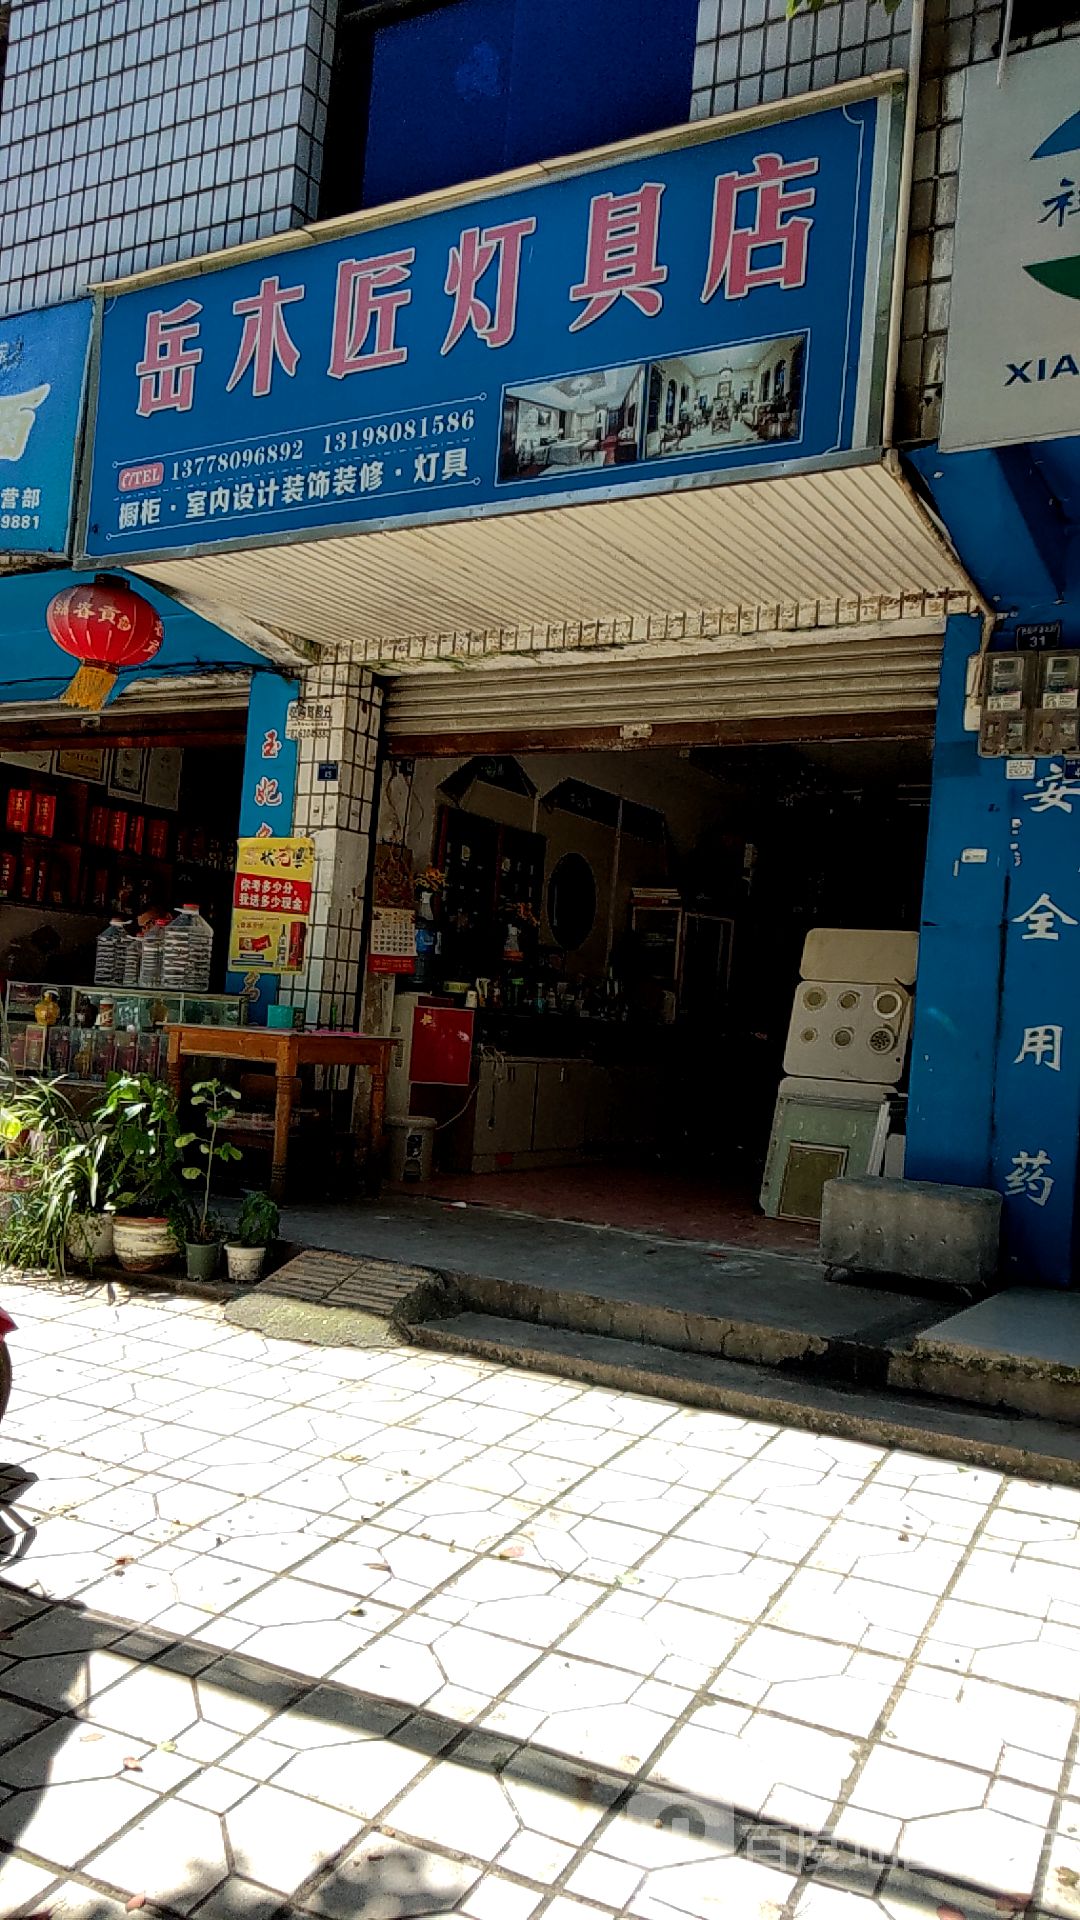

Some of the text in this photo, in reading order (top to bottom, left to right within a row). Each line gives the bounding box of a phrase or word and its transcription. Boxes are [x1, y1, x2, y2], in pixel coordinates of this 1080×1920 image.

[134, 152, 822, 419] 岳木匠灯具店
[133, 468, 161, 487] TEL
[170, 409, 475, 481] 13778096892 13198081586
[1029, 635, 1046, 649] 31
[1005, 763, 1080, 1208] 安全用药
